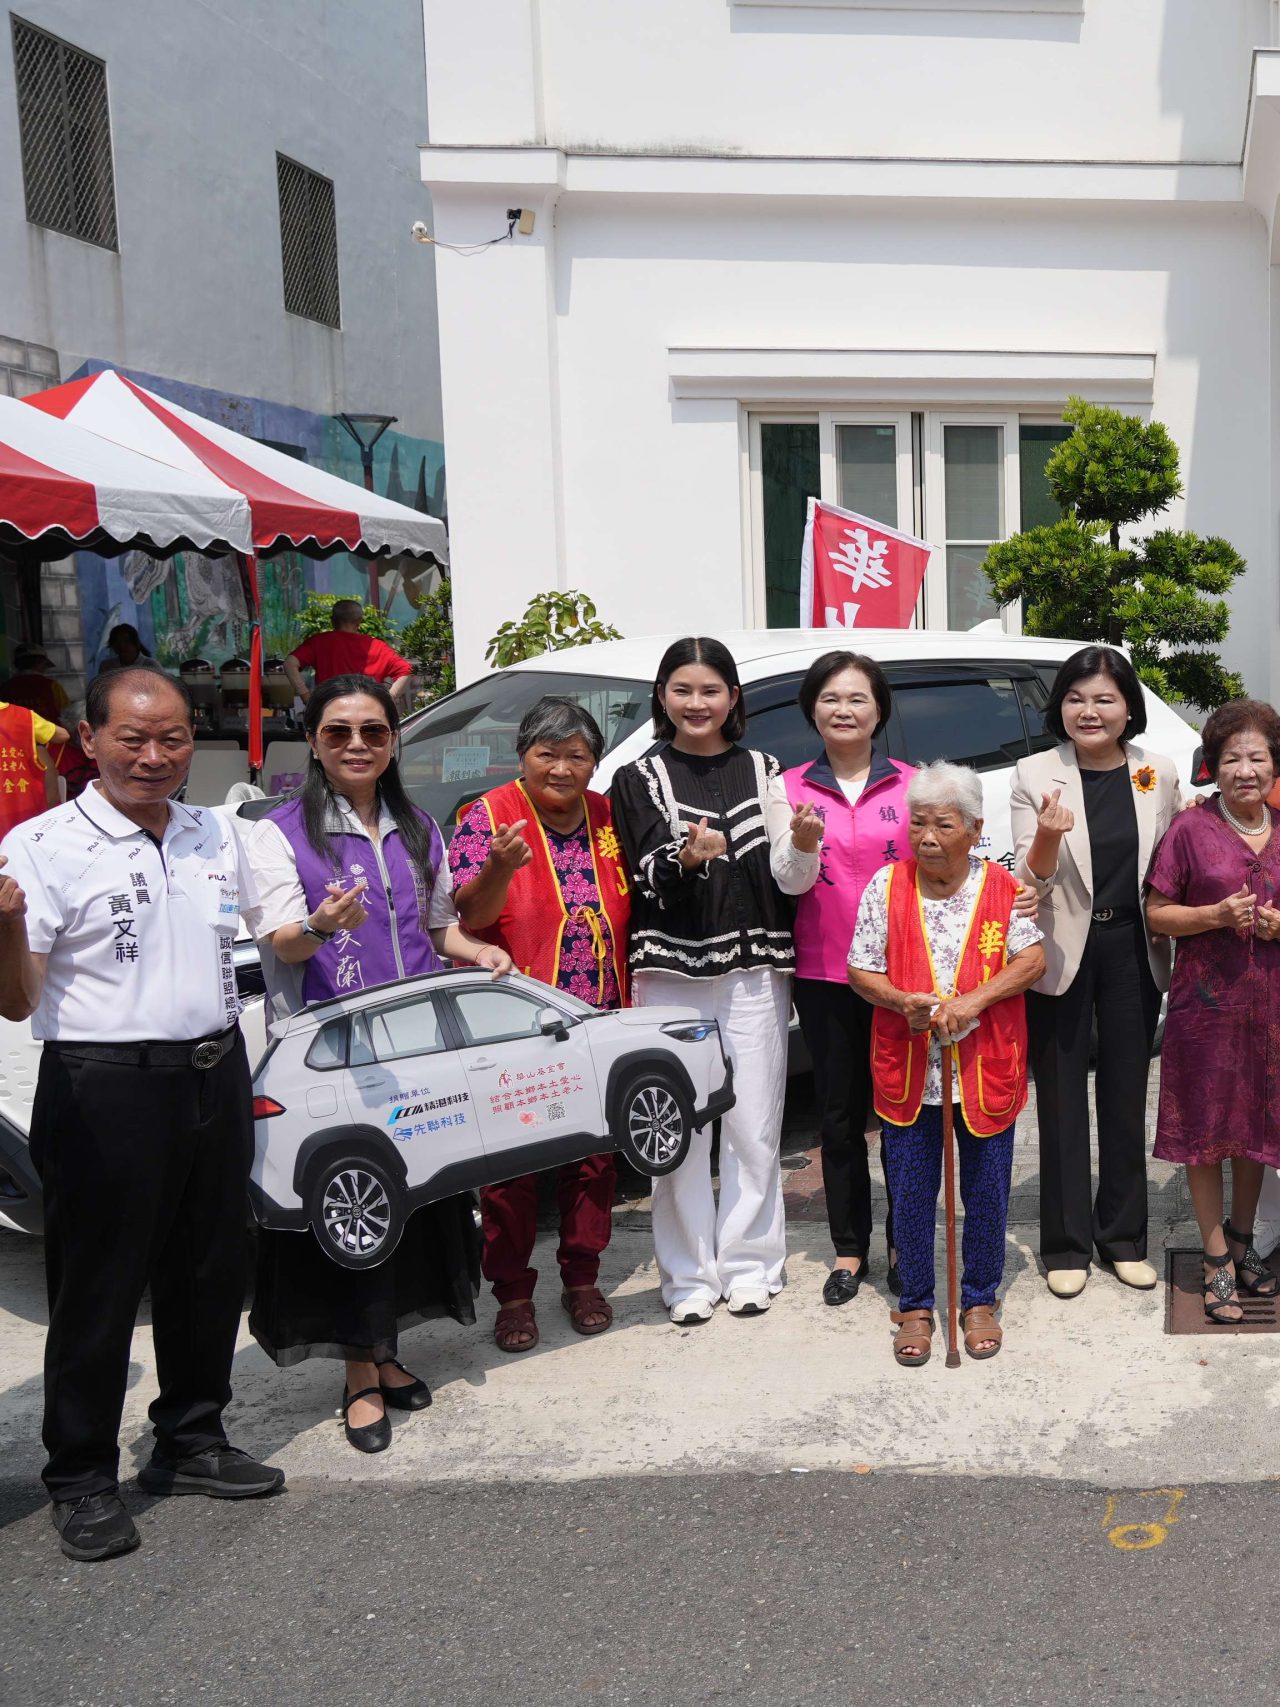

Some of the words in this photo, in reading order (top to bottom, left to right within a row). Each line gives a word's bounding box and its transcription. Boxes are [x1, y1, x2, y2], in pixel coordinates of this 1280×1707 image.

[879, 805, 900, 861] 鎮長
[129, 872, 152, 904] 議員
[208, 874, 227, 882] FILA
[107, 894, 139, 963] 黃文祥
[413, 1112, 467, 1136] 先聯科技
